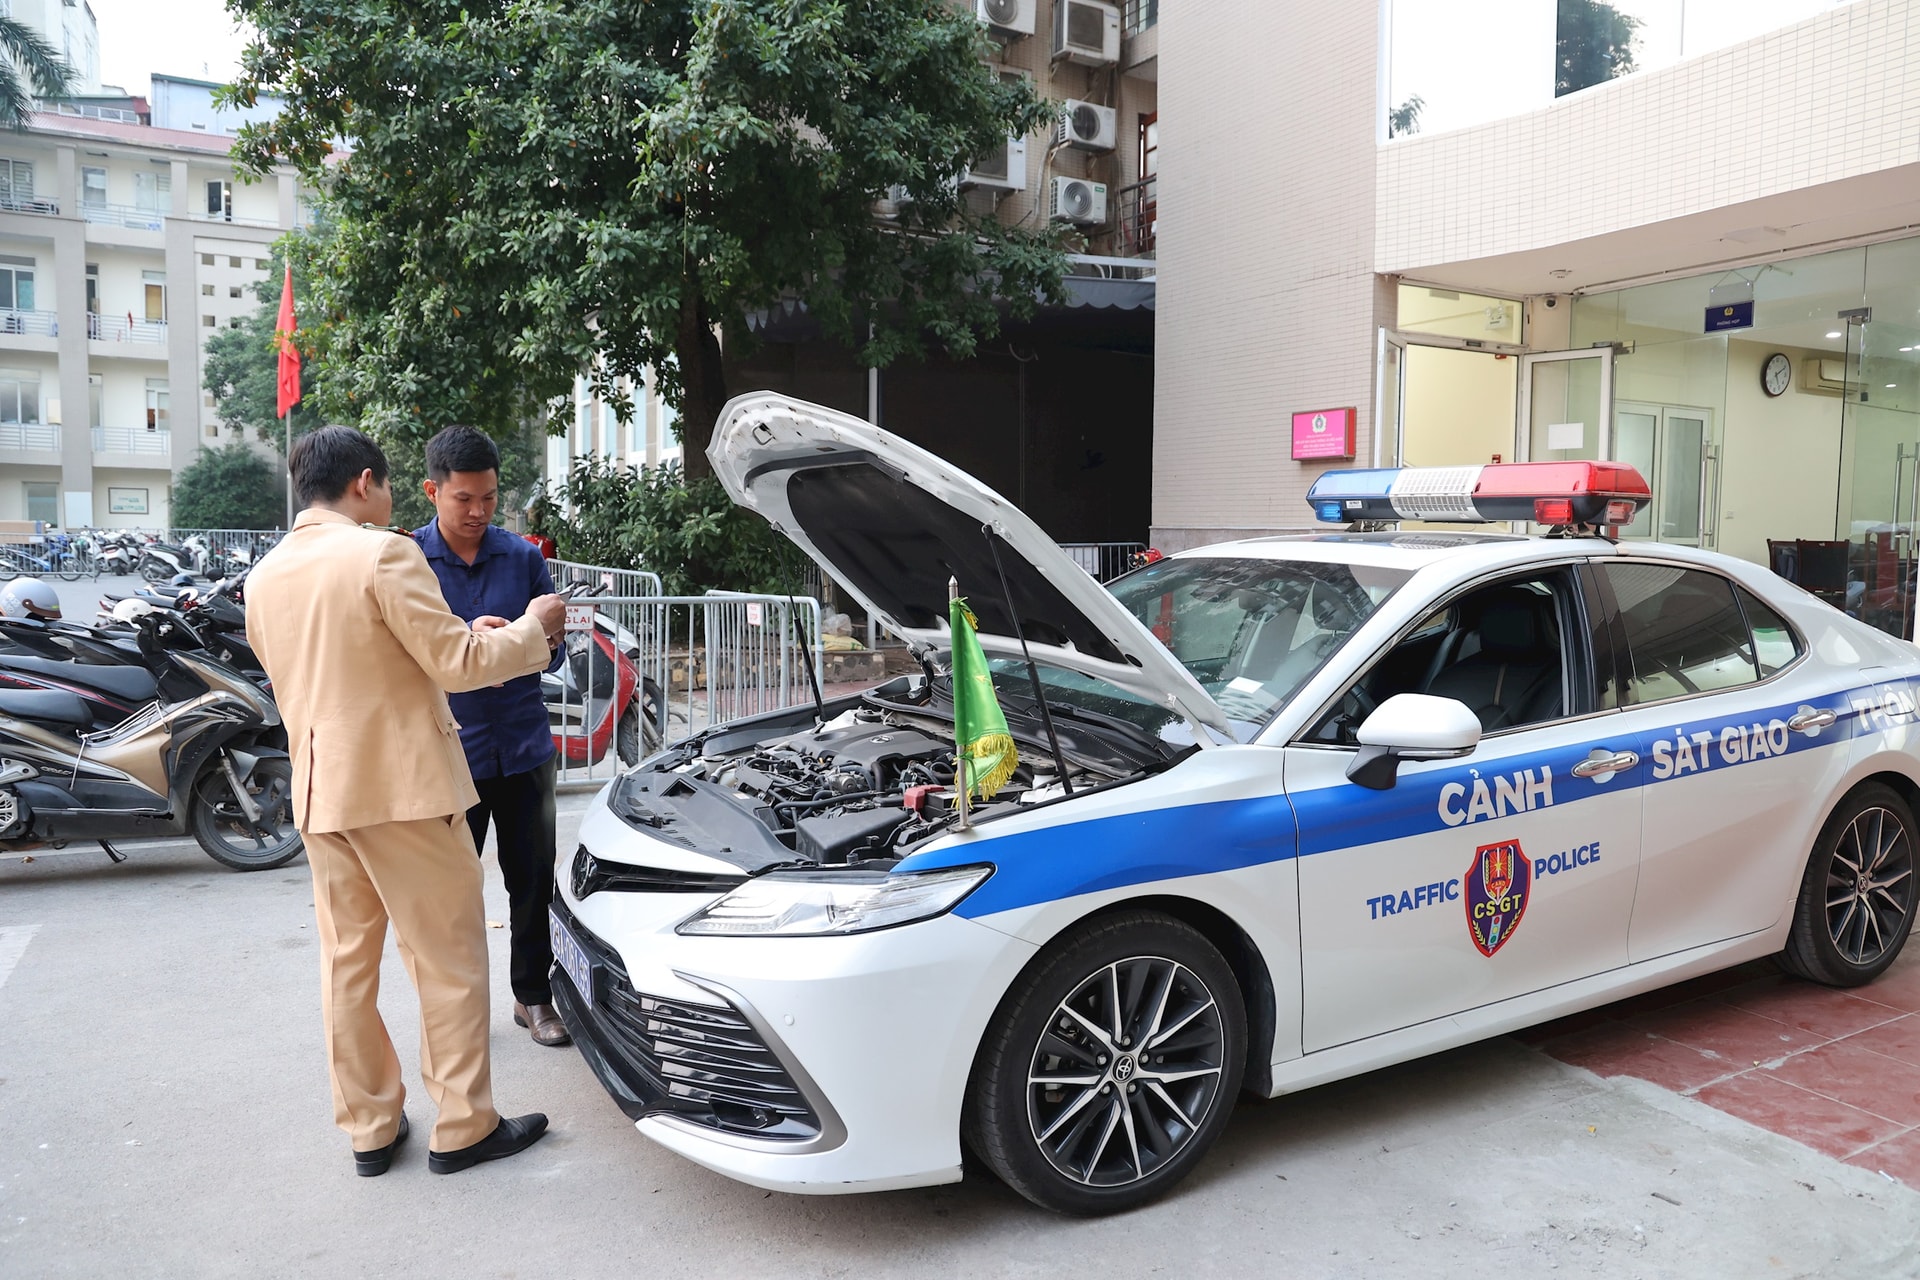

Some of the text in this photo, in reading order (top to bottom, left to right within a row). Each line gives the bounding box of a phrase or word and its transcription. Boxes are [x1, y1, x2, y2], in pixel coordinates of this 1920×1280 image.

[1437, 765, 1554, 827] CẢNH
[1719, 718, 1789, 764] GIAO
[1366, 841, 1601, 920] TRAFFIC POLICE
